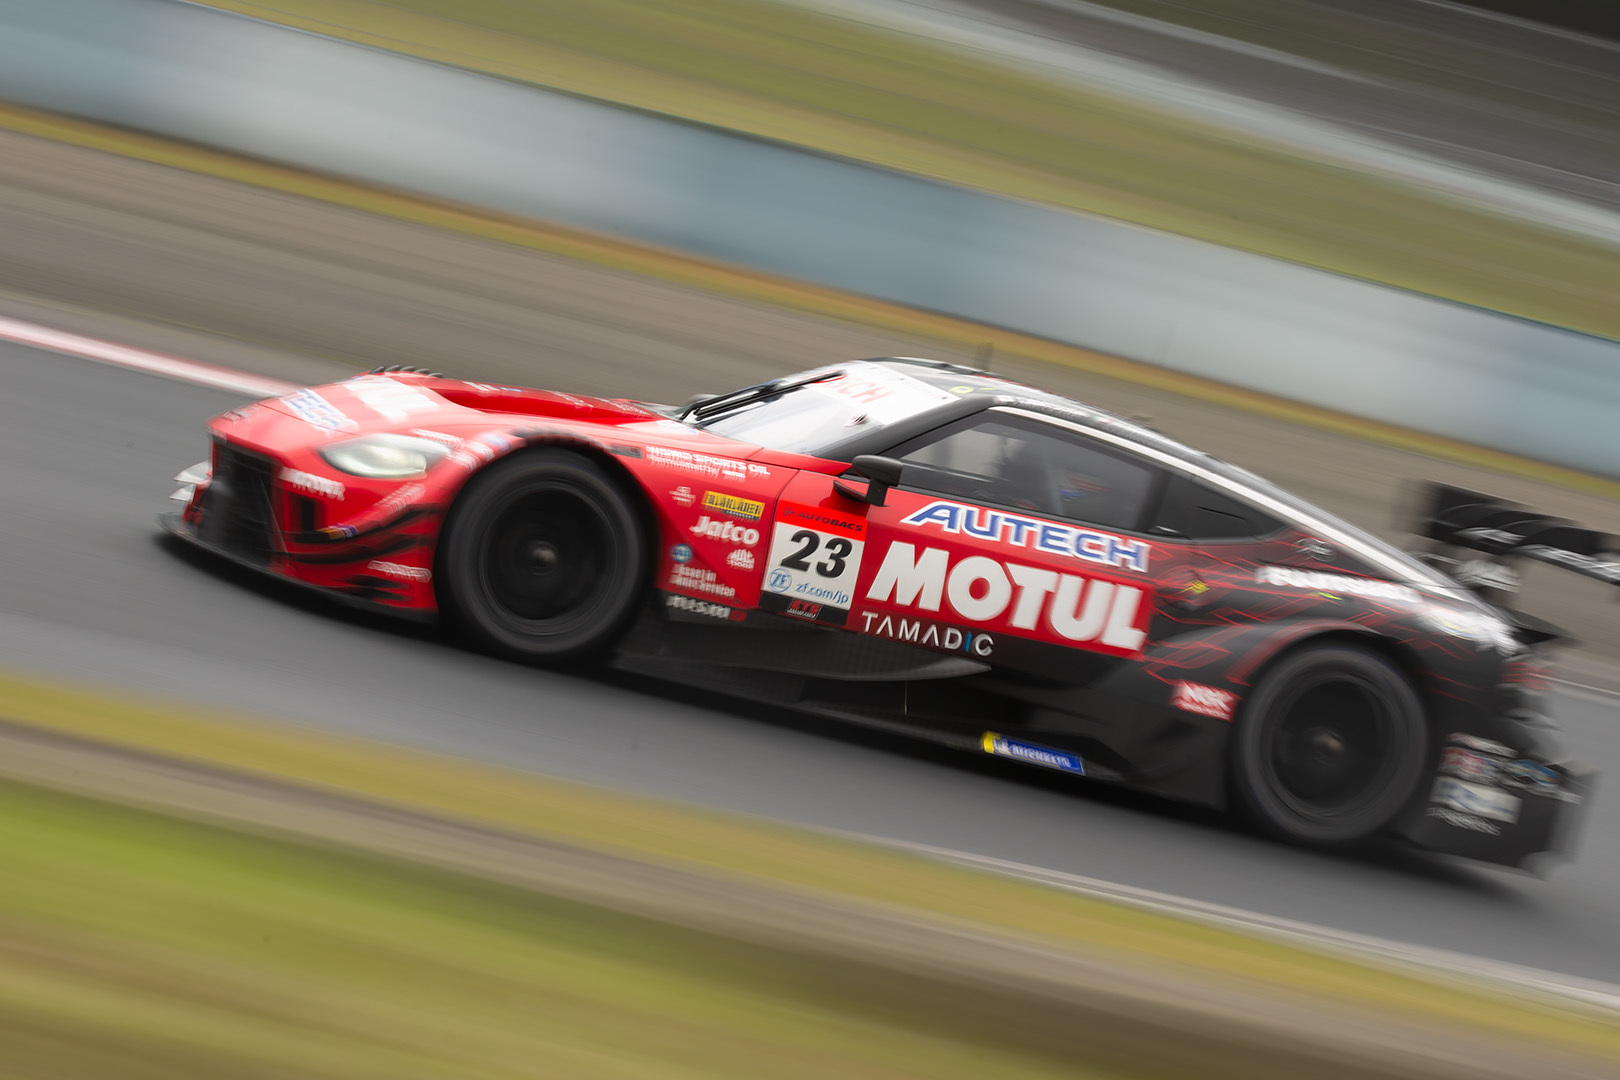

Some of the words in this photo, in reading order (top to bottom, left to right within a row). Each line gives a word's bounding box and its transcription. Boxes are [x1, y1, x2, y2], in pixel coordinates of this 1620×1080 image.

[693, 454, 747, 472] SPORTS
[747, 464, 771, 476] OIL
[689, 515, 760, 546] Jatco
[796, 510, 864, 532] AUTOBACS
[900, 500, 1152, 573] AUTECH
[779, 529, 854, 579] 23
[769, 571, 790, 590] ZF
[795, 582, 850, 605] zf.com/jp
[865, 540, 1148, 652] MOTUL
[861, 611, 994, 657] TAMADIC
